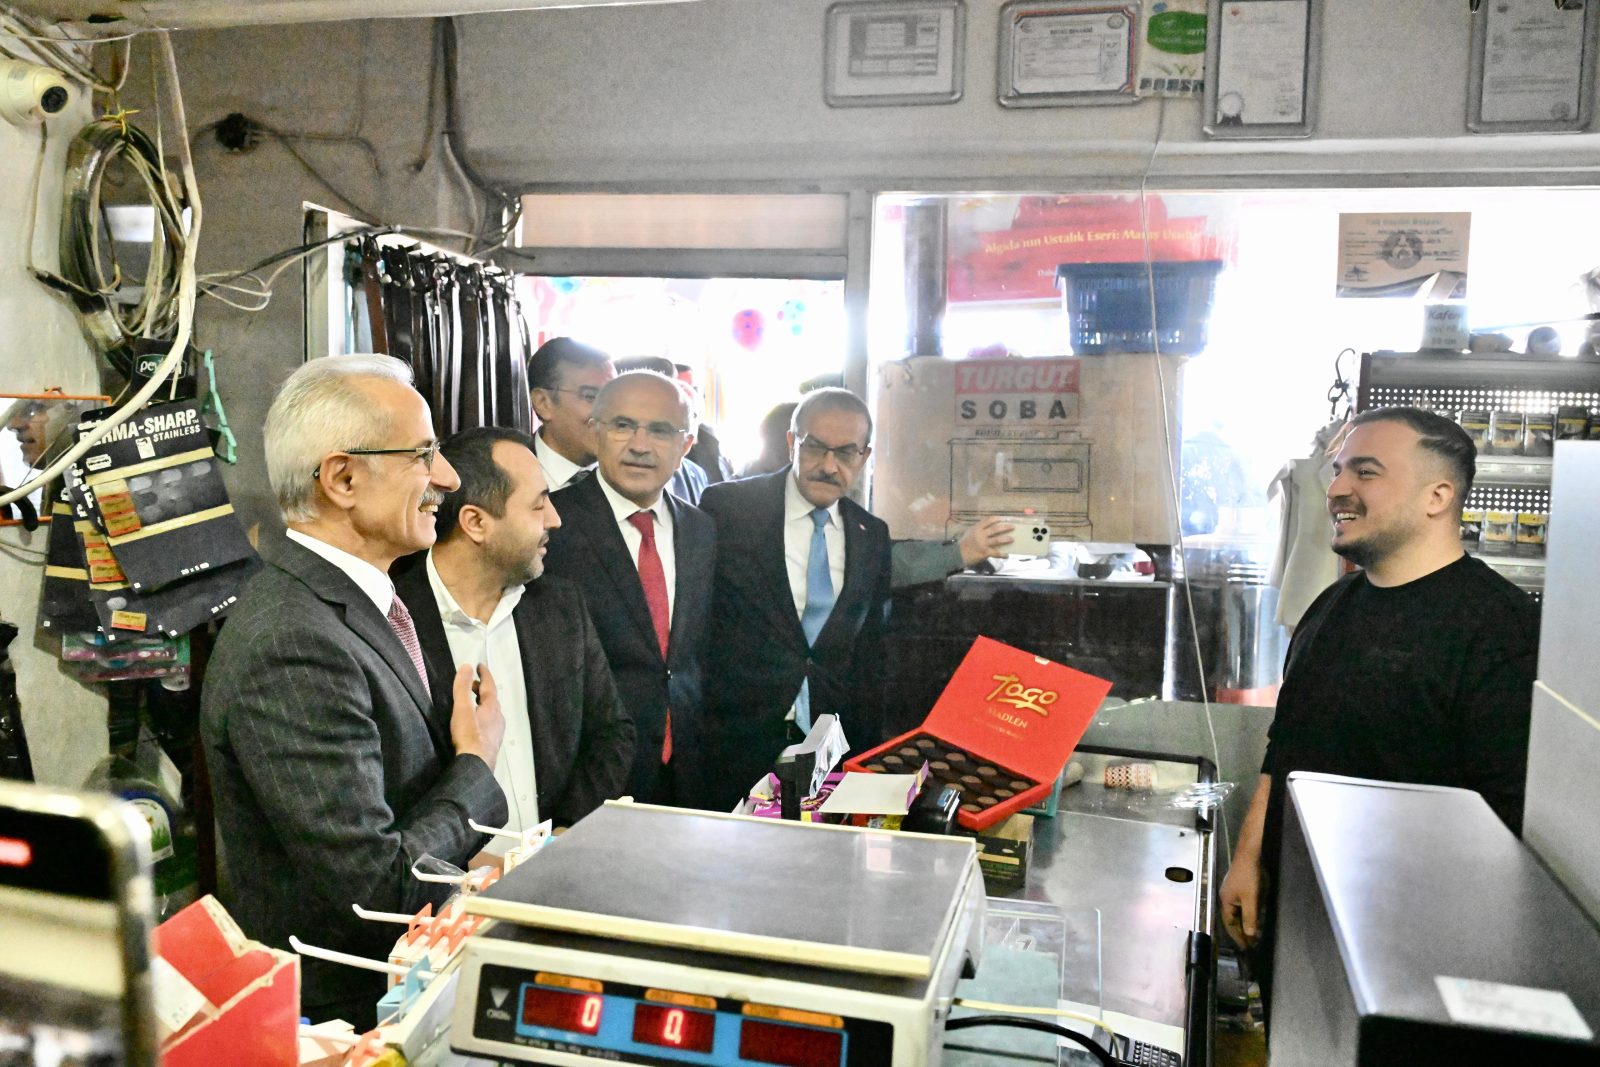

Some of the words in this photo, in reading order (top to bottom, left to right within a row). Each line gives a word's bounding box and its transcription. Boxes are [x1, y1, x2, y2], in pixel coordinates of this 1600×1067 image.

[960, 364, 1075, 390] TURGUT
[960, 399, 1068, 420] SOBA
[79, 408, 197, 447] PRMA-SHARP
[152, 424, 201, 443] STAINLESS
